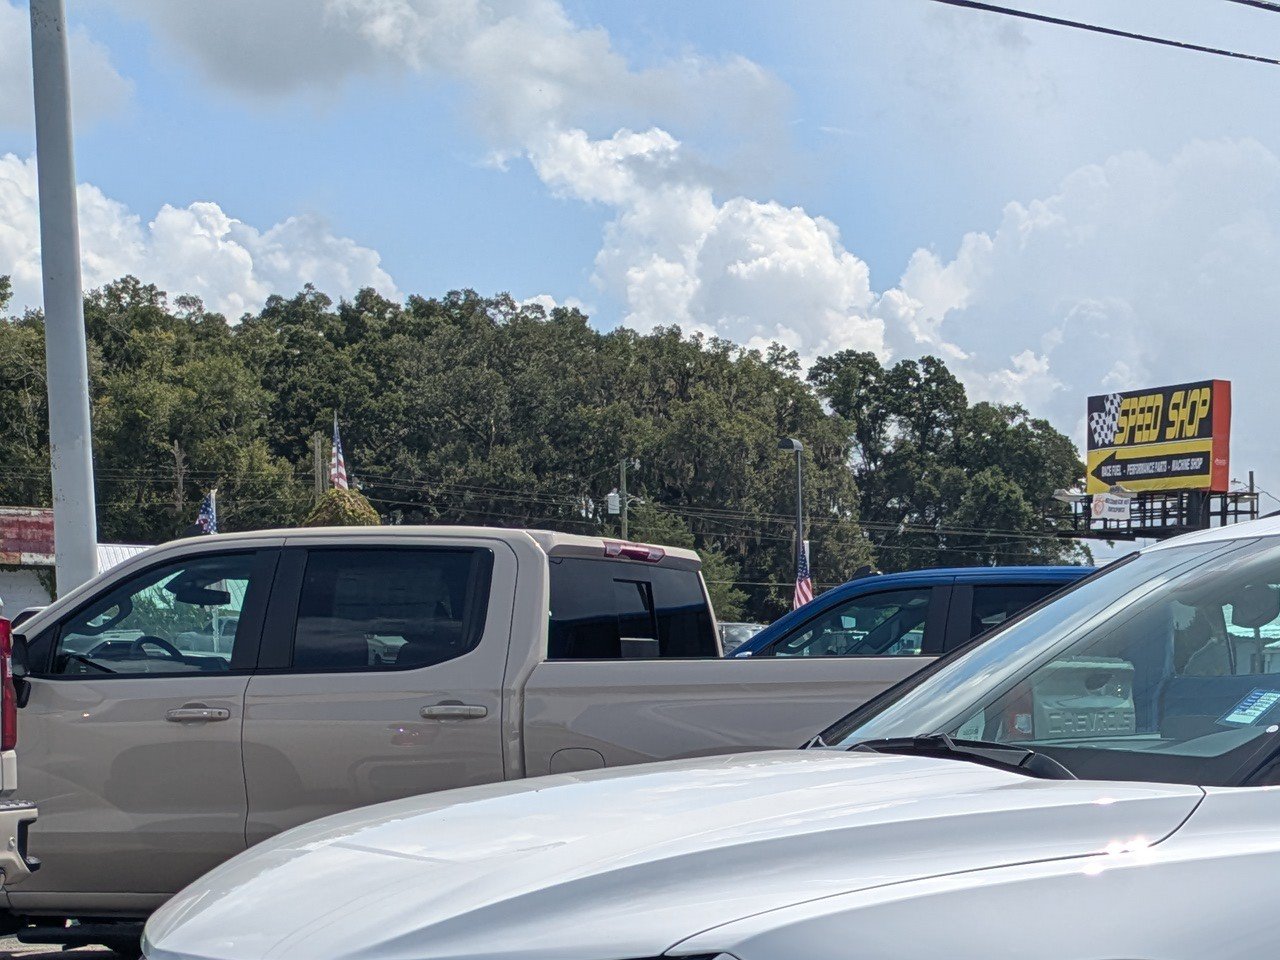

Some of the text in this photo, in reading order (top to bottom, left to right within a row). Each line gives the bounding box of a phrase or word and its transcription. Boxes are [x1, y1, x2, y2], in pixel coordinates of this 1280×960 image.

[1113, 387, 1211, 445] SPEED SHOP
[1190, 457, 1204, 470] SHOP
[1048, 712, 1135, 733] CHEVROLE
